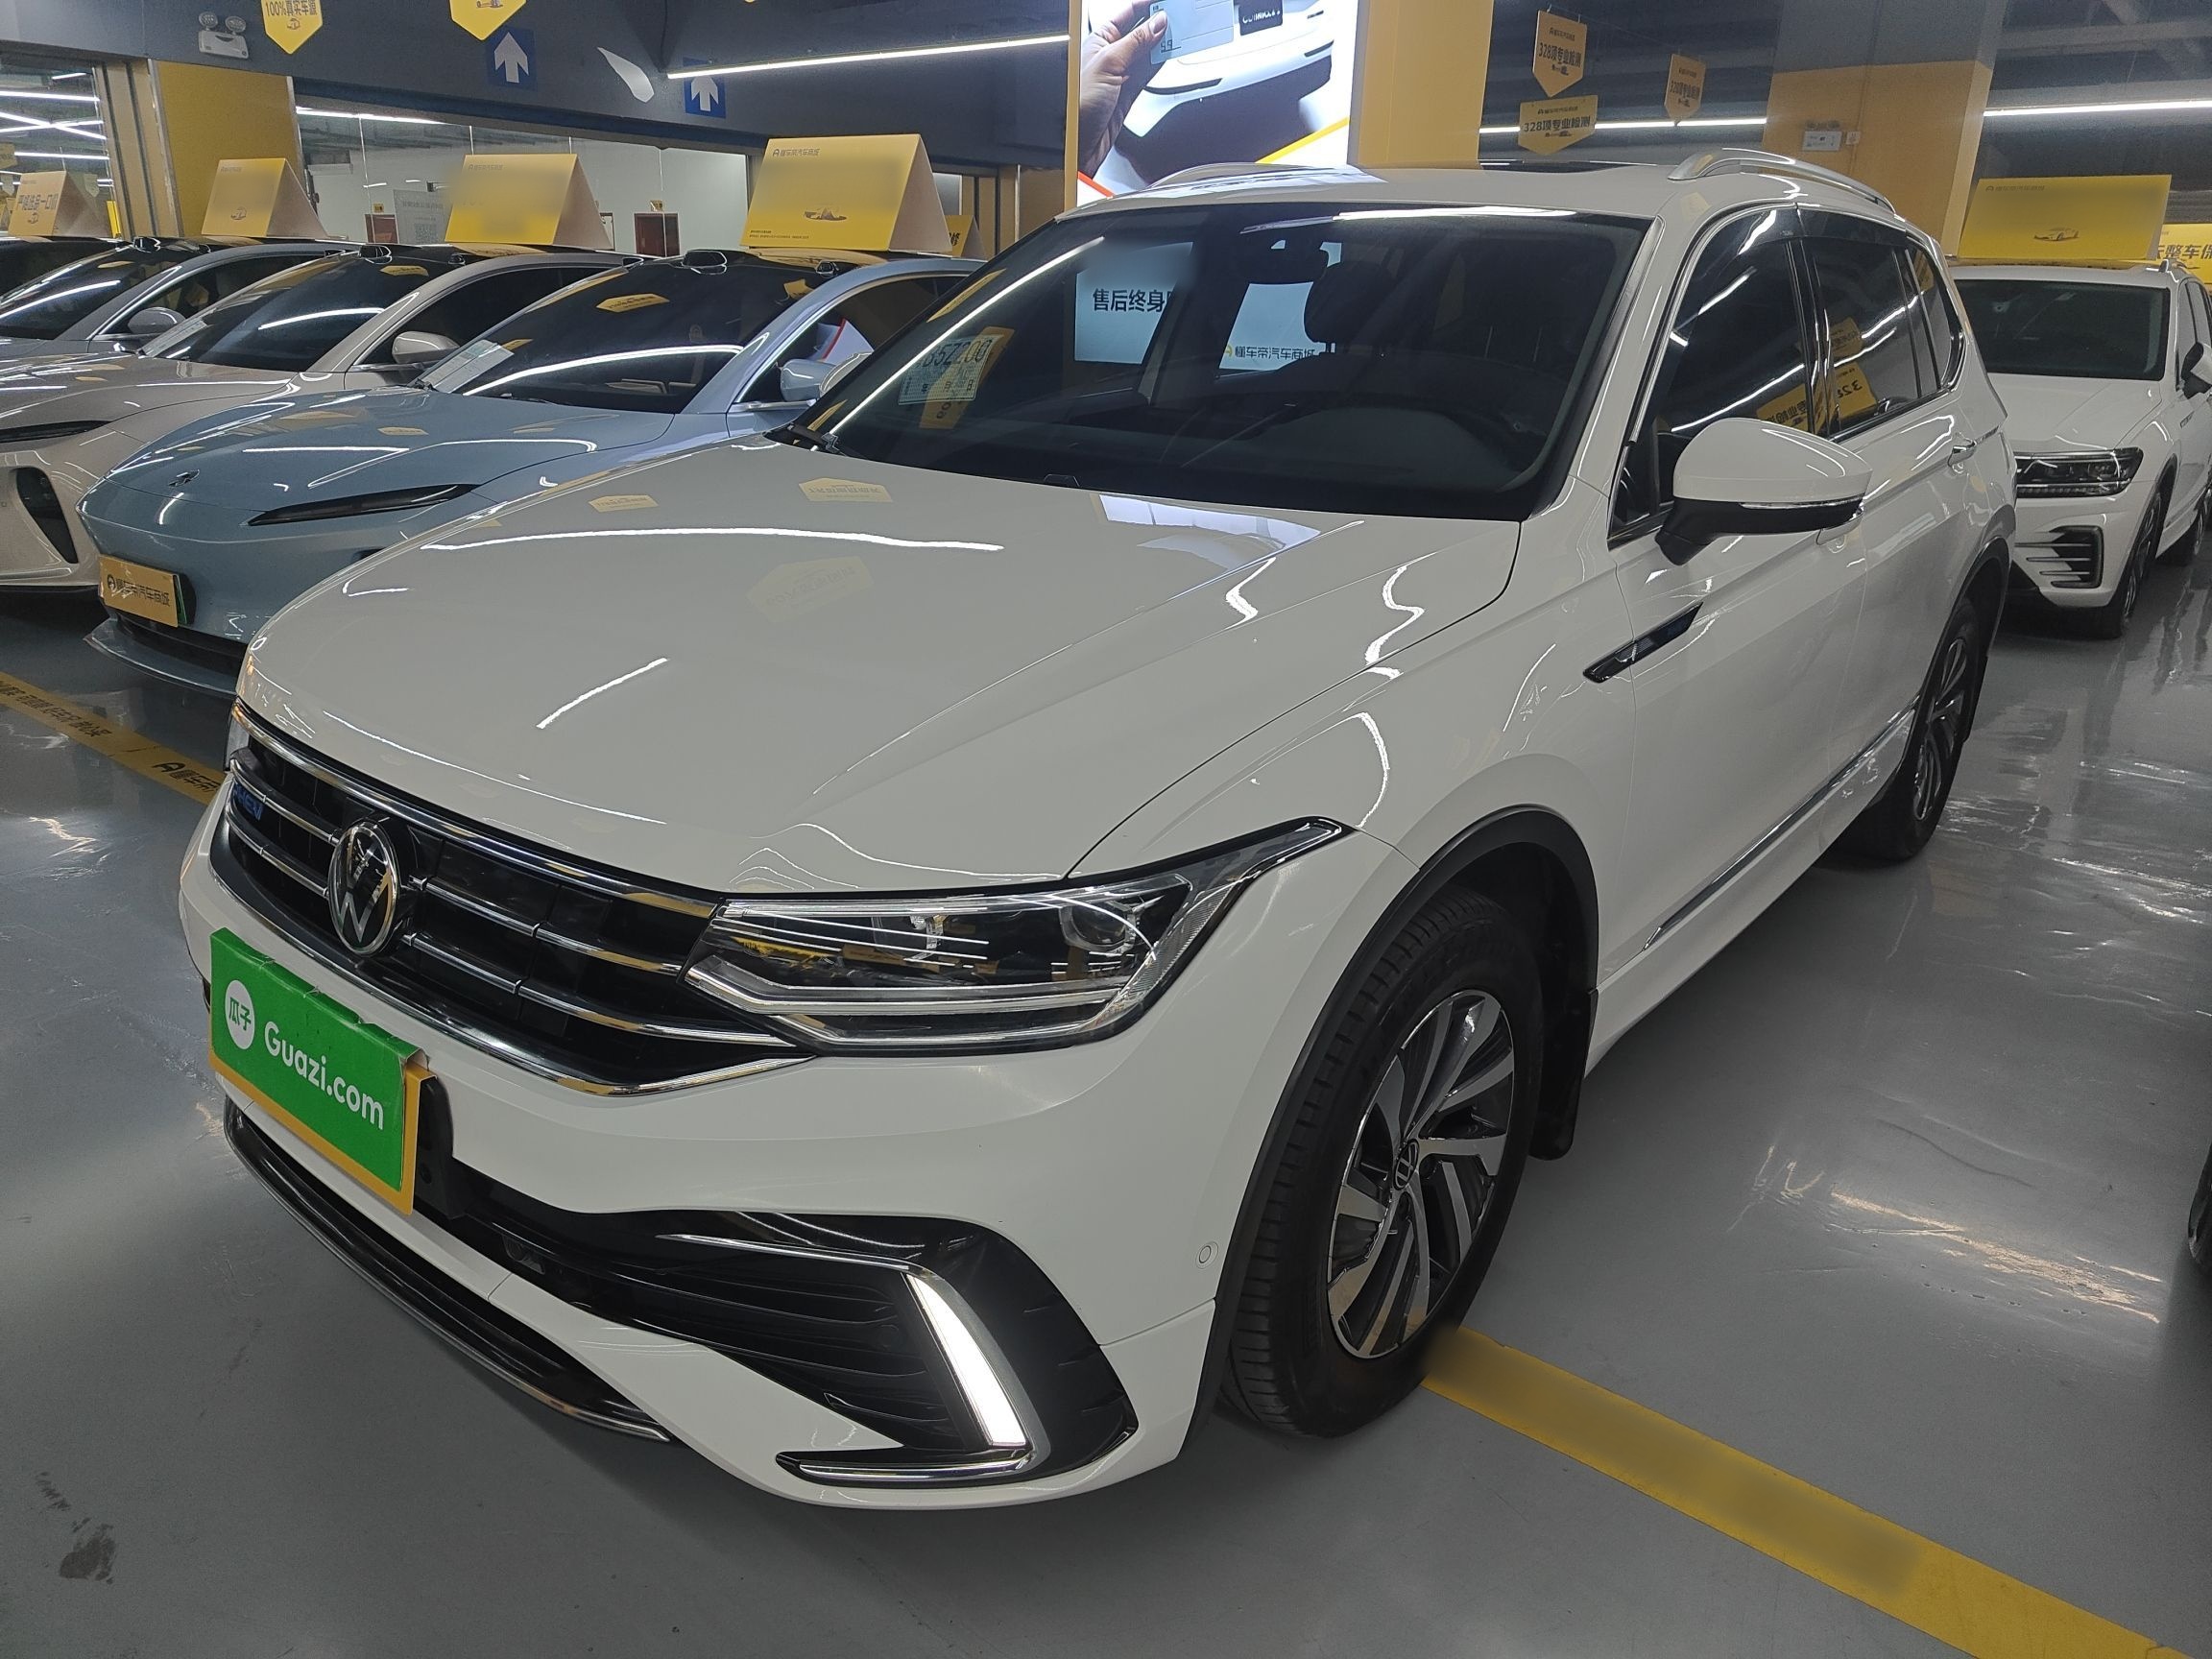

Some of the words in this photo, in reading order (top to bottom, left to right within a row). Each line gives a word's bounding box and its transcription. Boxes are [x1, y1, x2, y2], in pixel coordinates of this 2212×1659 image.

[1538, 41, 1582, 68] 328项专业检测
[1524, 115, 1591, 132] 328项专业检测
[1093, 288, 1171, 312] 售后终身
[228, 997, 252, 1034] 瓜子
[264, 1021, 384, 1130] Guazi.com
